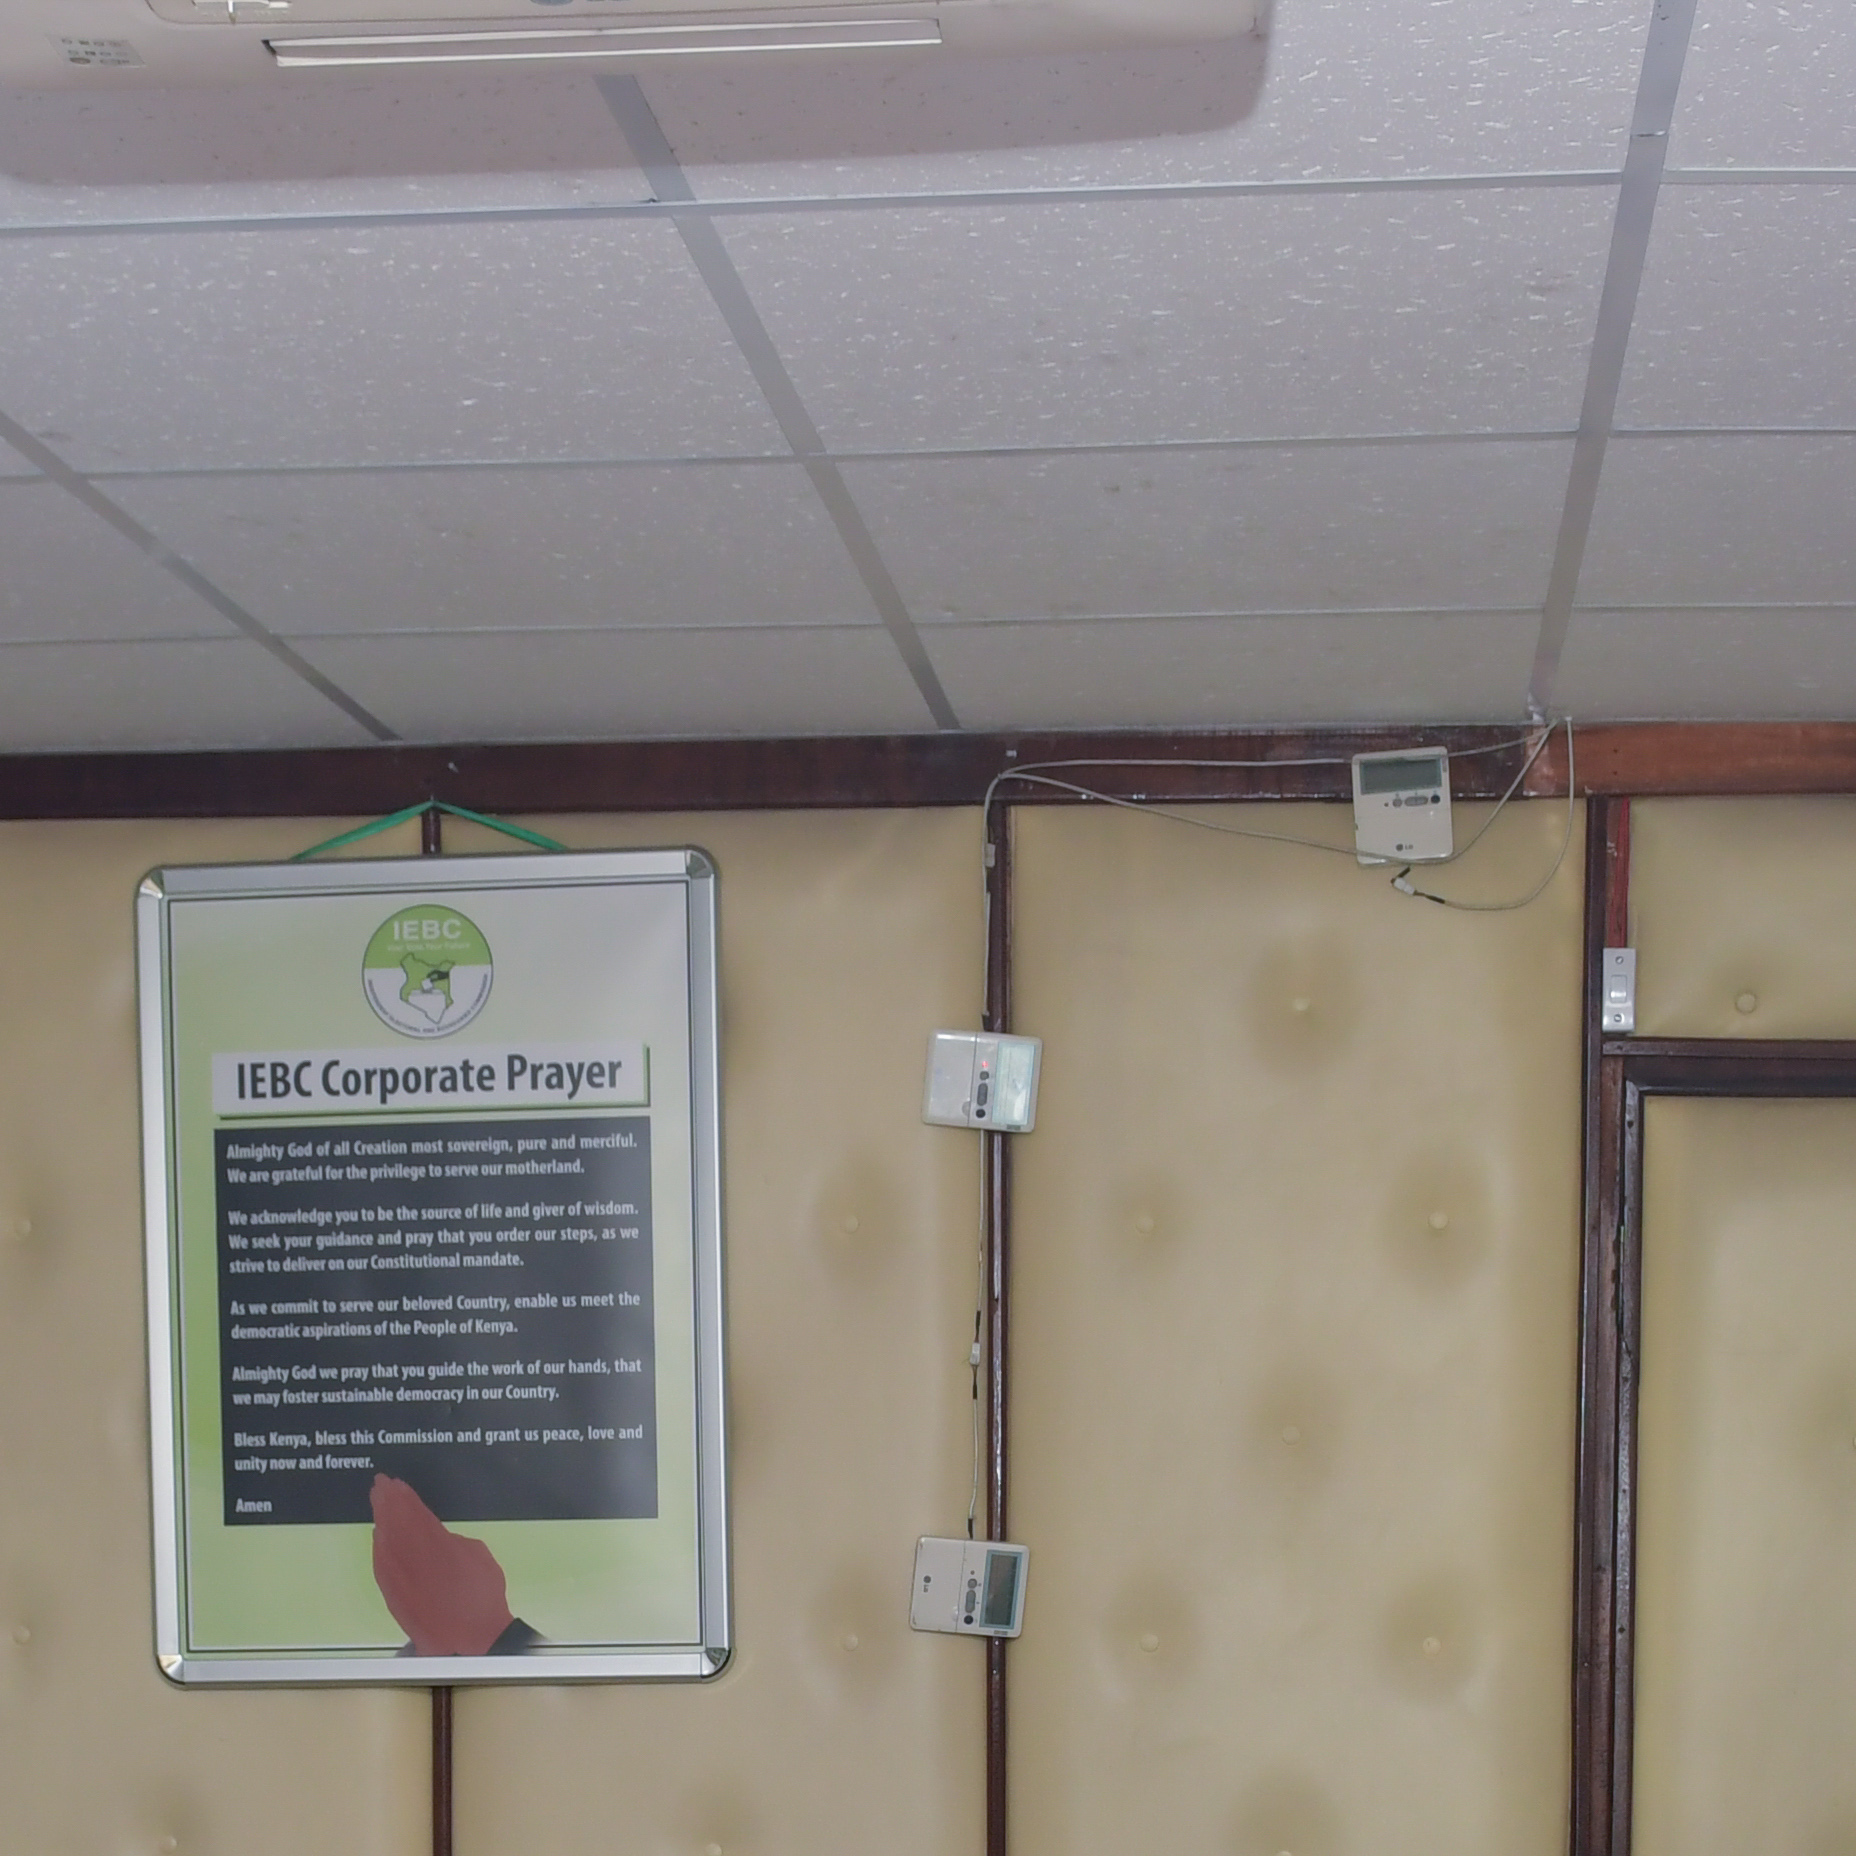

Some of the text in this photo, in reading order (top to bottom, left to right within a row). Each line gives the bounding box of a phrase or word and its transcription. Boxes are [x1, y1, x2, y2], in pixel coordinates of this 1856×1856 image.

[393, 918, 463, 941] IEBC
[237, 1053, 623, 1105] IEBC Corporate Prayer
[226, 1133, 637, 1163] Almighty God of all Creation most sovereign, pure and merciful.
[227, 1158, 585, 1186] We are grateful for the privilege to serve our motherland.
[228, 1200, 638, 1229] We acknowledge you to be the source of life and giver of wisdom.
[228, 1226, 639, 1252] We seek your guidance and pray that you order our steps, as we
[229, 1251, 524, 1274] strive to deliver on our Constitutional mandate.
[230, 1291, 640, 1316] As we commit to serve our beloved Country, enable us meet the
[231, 1318, 518, 1341] democratic aspirations of the People of Kenya.
[232, 1357, 641, 1385] Almighty God we pray that you guide the work of our hands, that
[232, 1384, 559, 1408] we may foster sustainable democracy in our Country.
[234, 1424, 643, 1450] Bless Kenya, bless this Commission and grant us peace, love and
[234, 1453, 374, 1474] unity now and forever.
[235, 1498, 272, 1513] Amen
